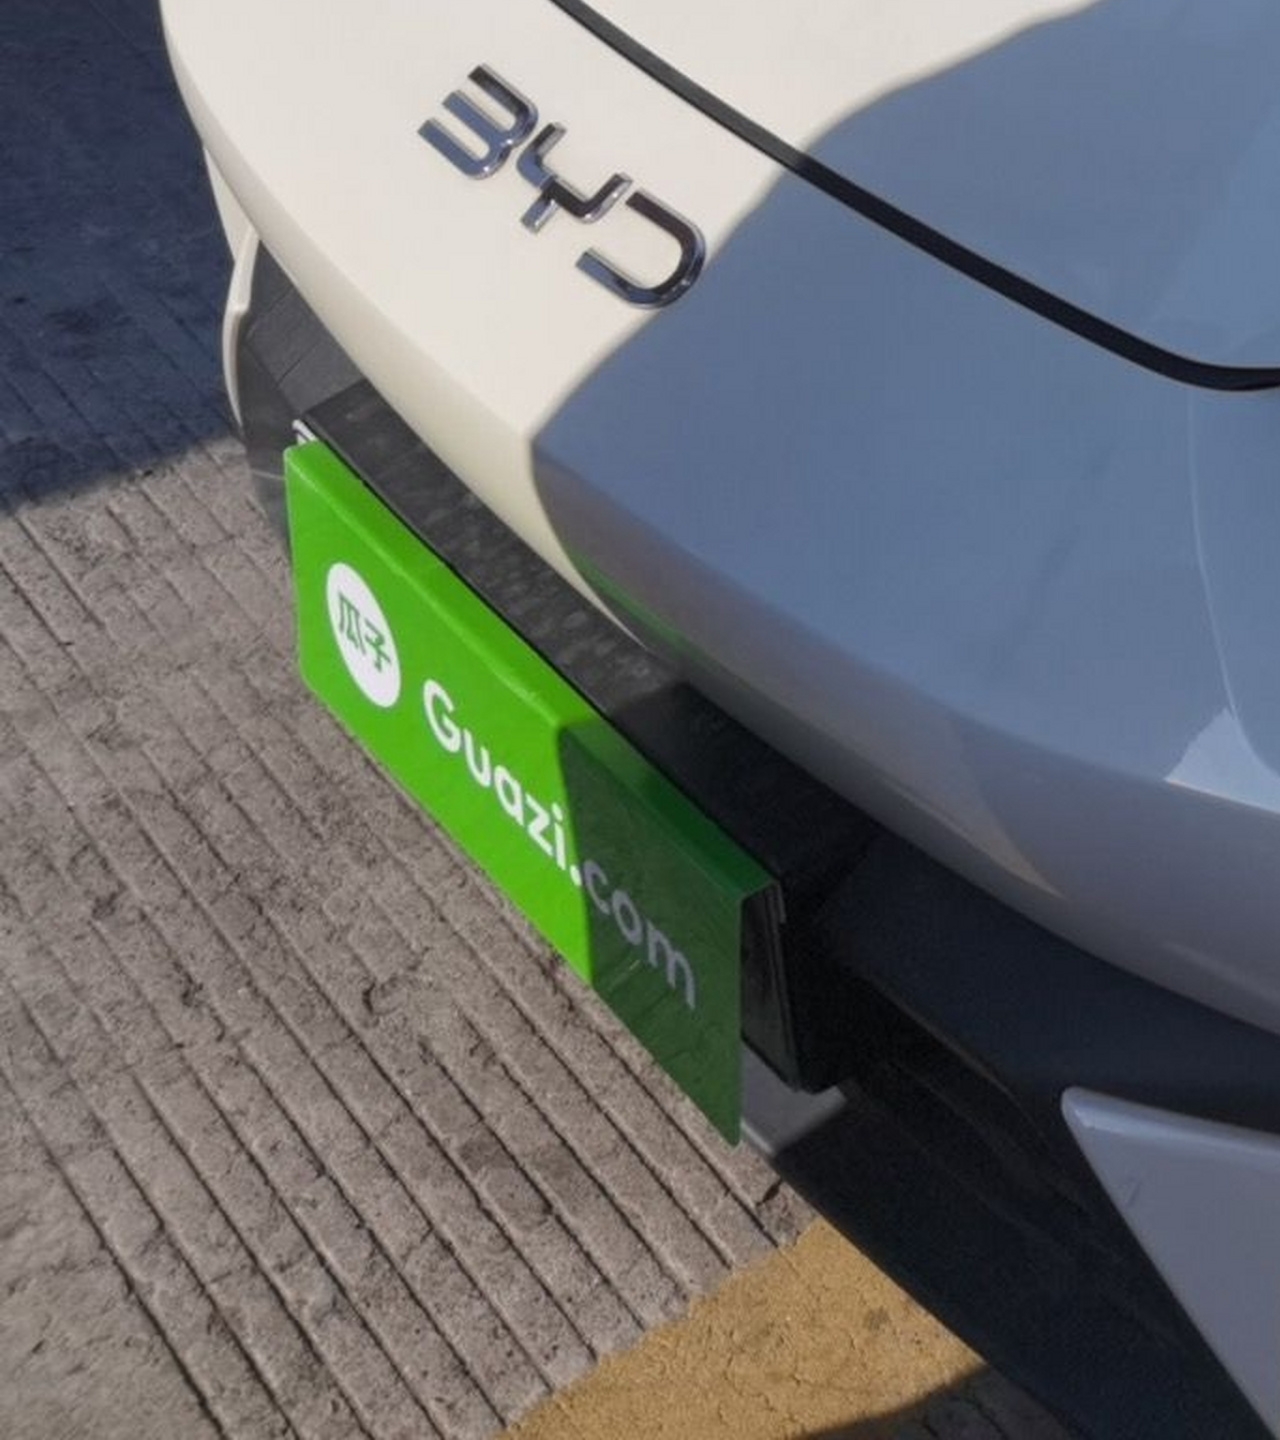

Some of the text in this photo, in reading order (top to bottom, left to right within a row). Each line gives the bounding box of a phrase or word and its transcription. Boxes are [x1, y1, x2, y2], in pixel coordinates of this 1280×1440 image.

[417, 63, 706, 309] BYD
[336, 587, 393, 676] 瓜子
[423, 679, 697, 1011] Guazi.com
